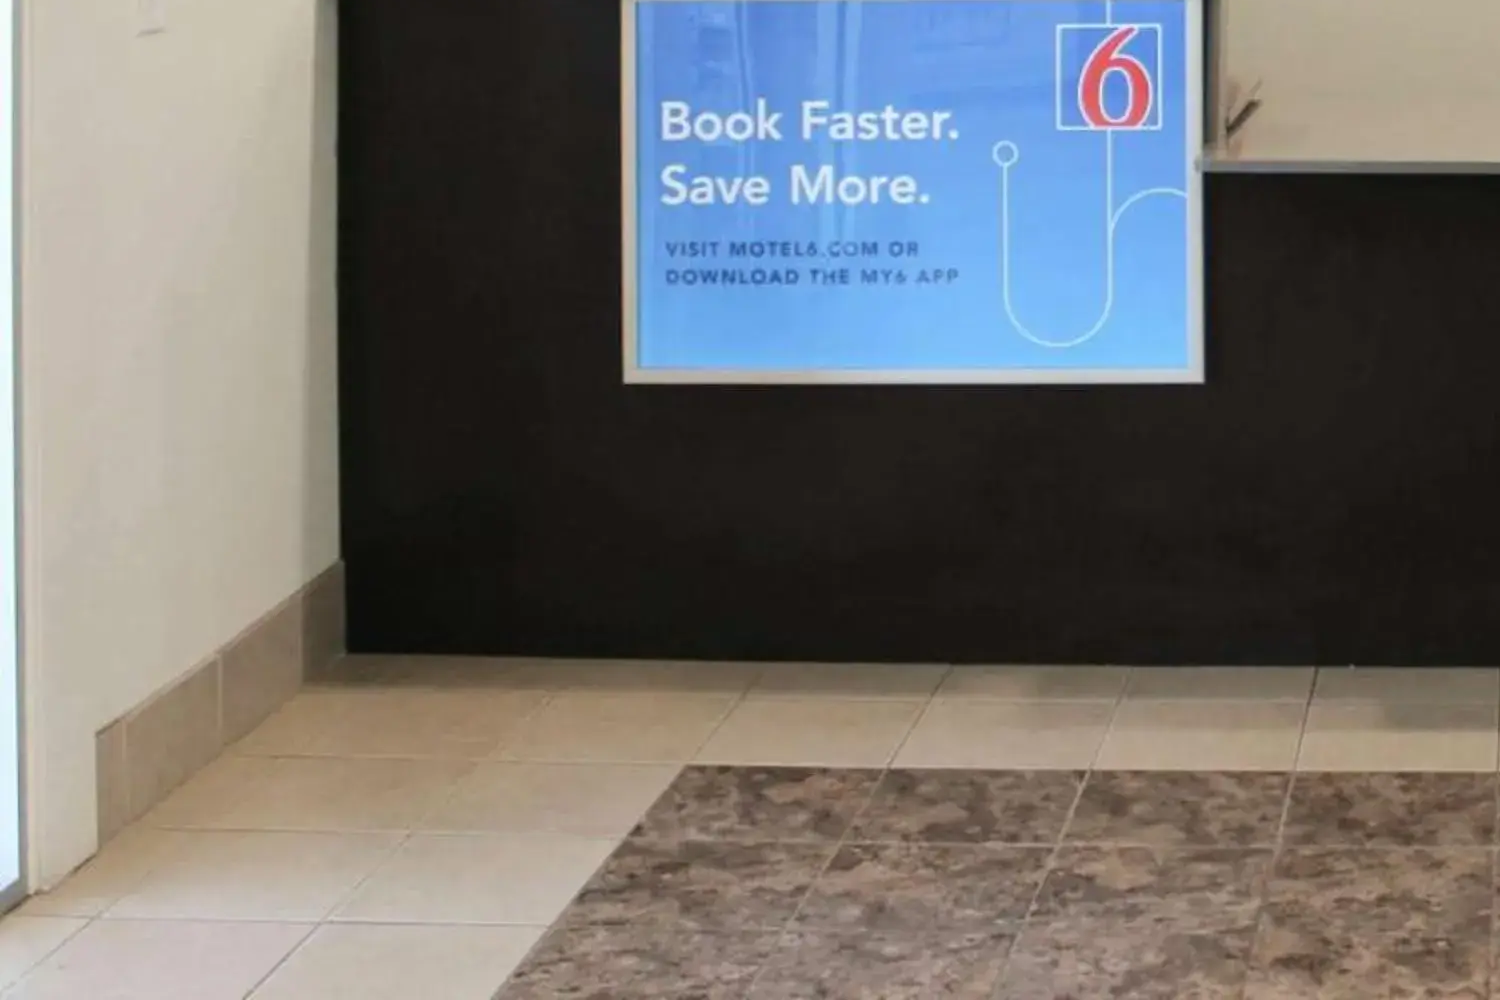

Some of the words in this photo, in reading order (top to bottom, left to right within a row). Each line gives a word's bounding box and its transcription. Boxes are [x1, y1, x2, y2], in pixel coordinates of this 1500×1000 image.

[1078, 25, 1152, 129] 6
[660, 99, 782, 142] Book
[801, 100, 960, 141] Faster.
[660, 165, 770, 205] Save
[790, 165, 930, 205] More.
[665, 241, 720, 259] VISIT
[729, 241, 878, 259] MOTEL6.COM
[888, 241, 919, 258] OR
[666, 268, 800, 286] DOWNLOAD
[808, 268, 850, 286] THE
[860, 268, 908, 286] MY6
[917, 268, 960, 286] APP
